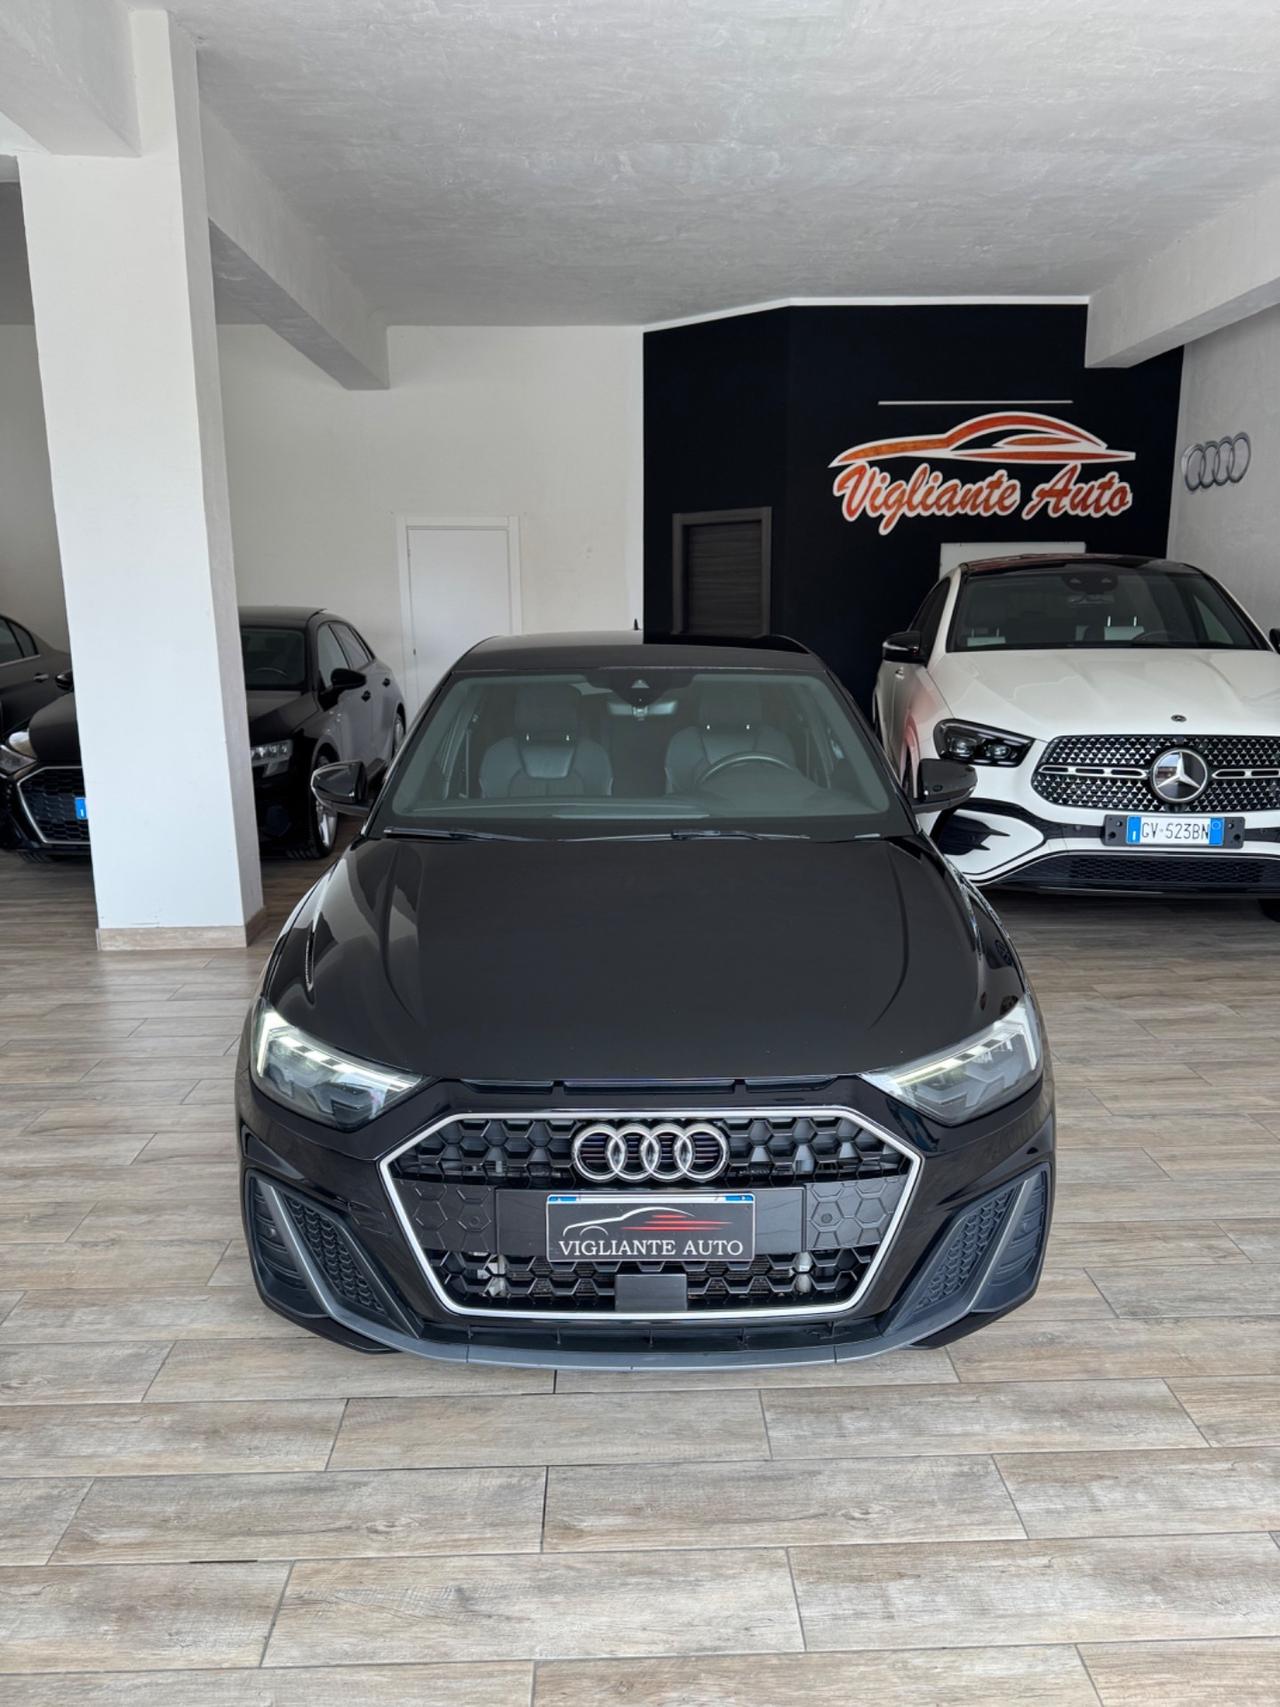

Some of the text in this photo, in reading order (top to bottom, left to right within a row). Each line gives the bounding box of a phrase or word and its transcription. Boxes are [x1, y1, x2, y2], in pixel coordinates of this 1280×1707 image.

[833, 462, 1133, 535] Vigliante Auto
[558, 1240, 743, 1256] VIGLIANTE AUTO
